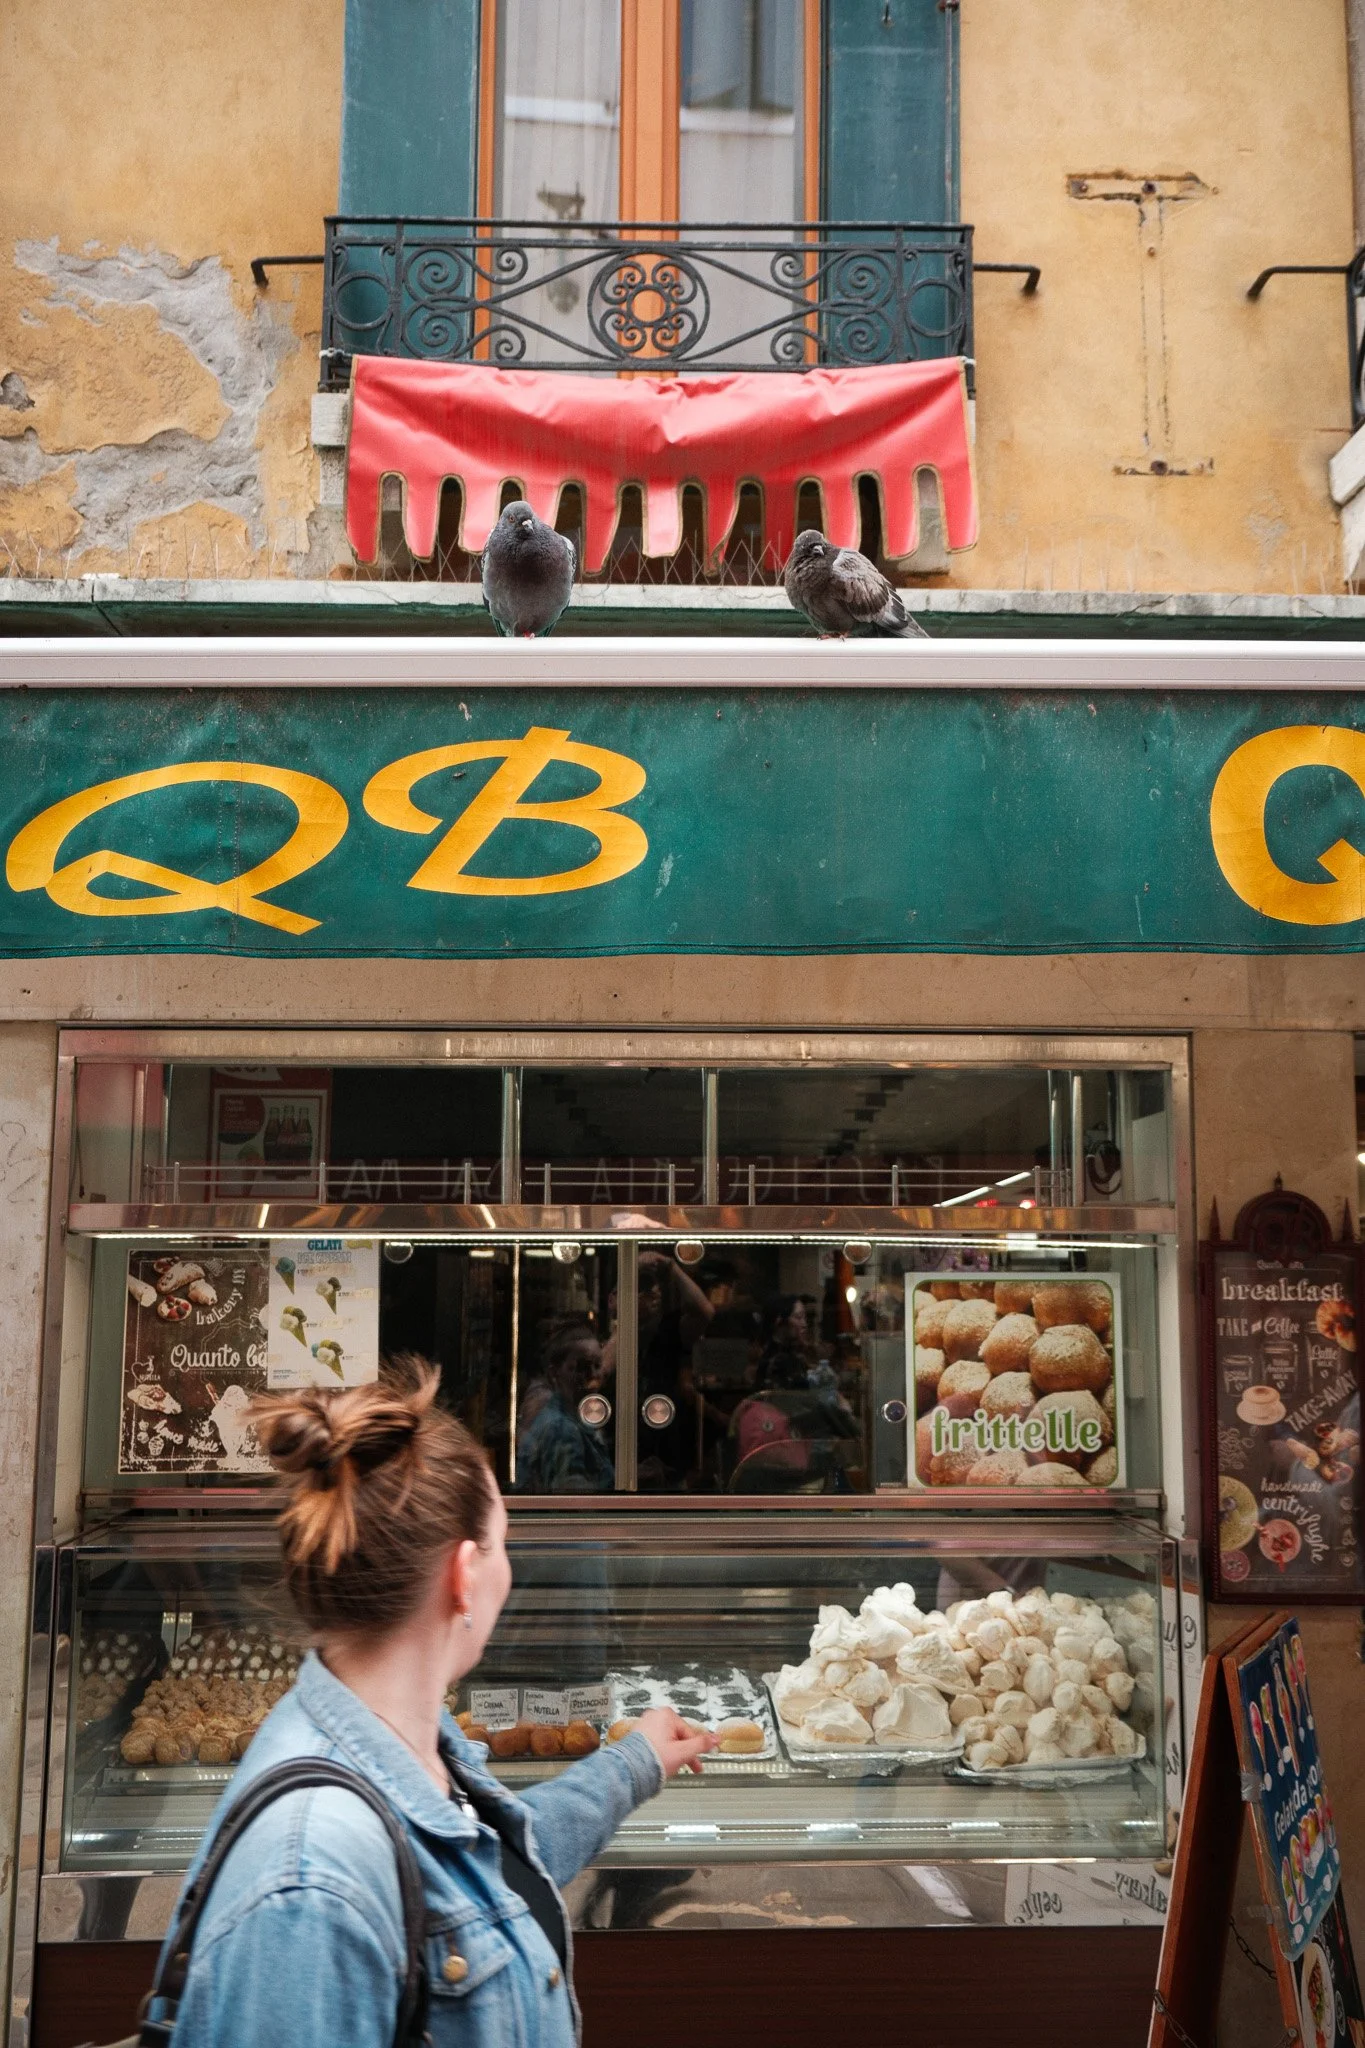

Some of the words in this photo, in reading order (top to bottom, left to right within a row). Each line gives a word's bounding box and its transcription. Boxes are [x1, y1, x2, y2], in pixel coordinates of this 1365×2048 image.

[6, 726, 649, 935] QB
[308, 1239, 342, 1251] GELATI
[1221, 1276, 1345, 1301] breakfast
[1216, 1317, 1249, 1337] TAKE
[170, 1343, 241, 1373] Quanto
[931, 1408, 1101, 1455] frittelle
[533, 1705, 560, 1716] NUTELLA
